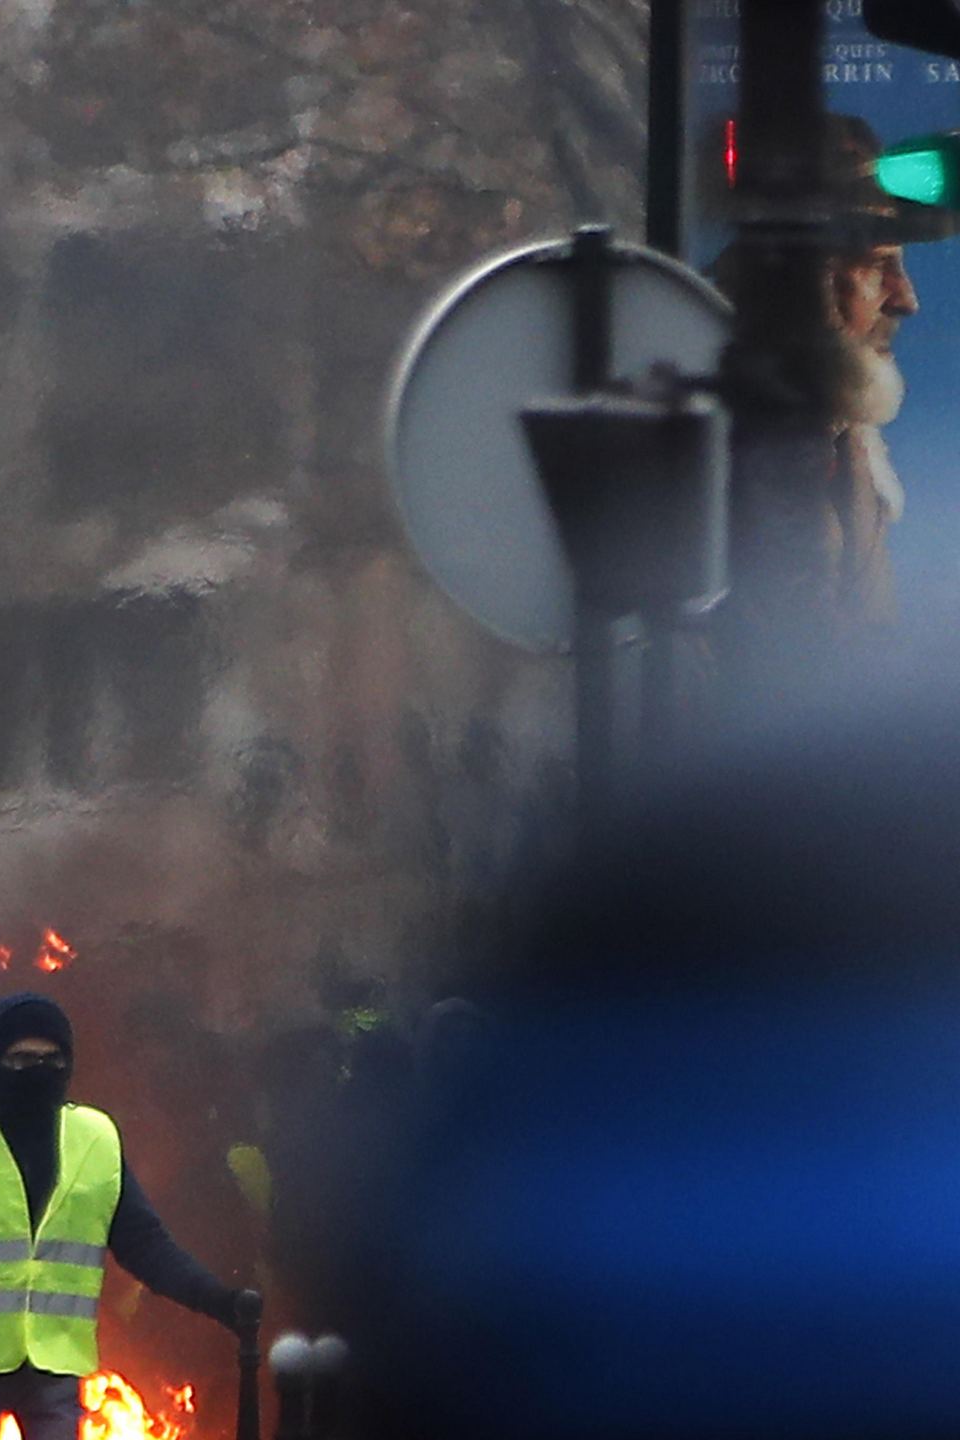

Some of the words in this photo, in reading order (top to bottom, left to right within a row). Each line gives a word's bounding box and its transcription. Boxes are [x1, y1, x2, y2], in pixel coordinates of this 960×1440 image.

[835, 43, 887, 61] QUES
[824, 63, 893, 82] RRIN
[927, 63, 960, 82] SA
